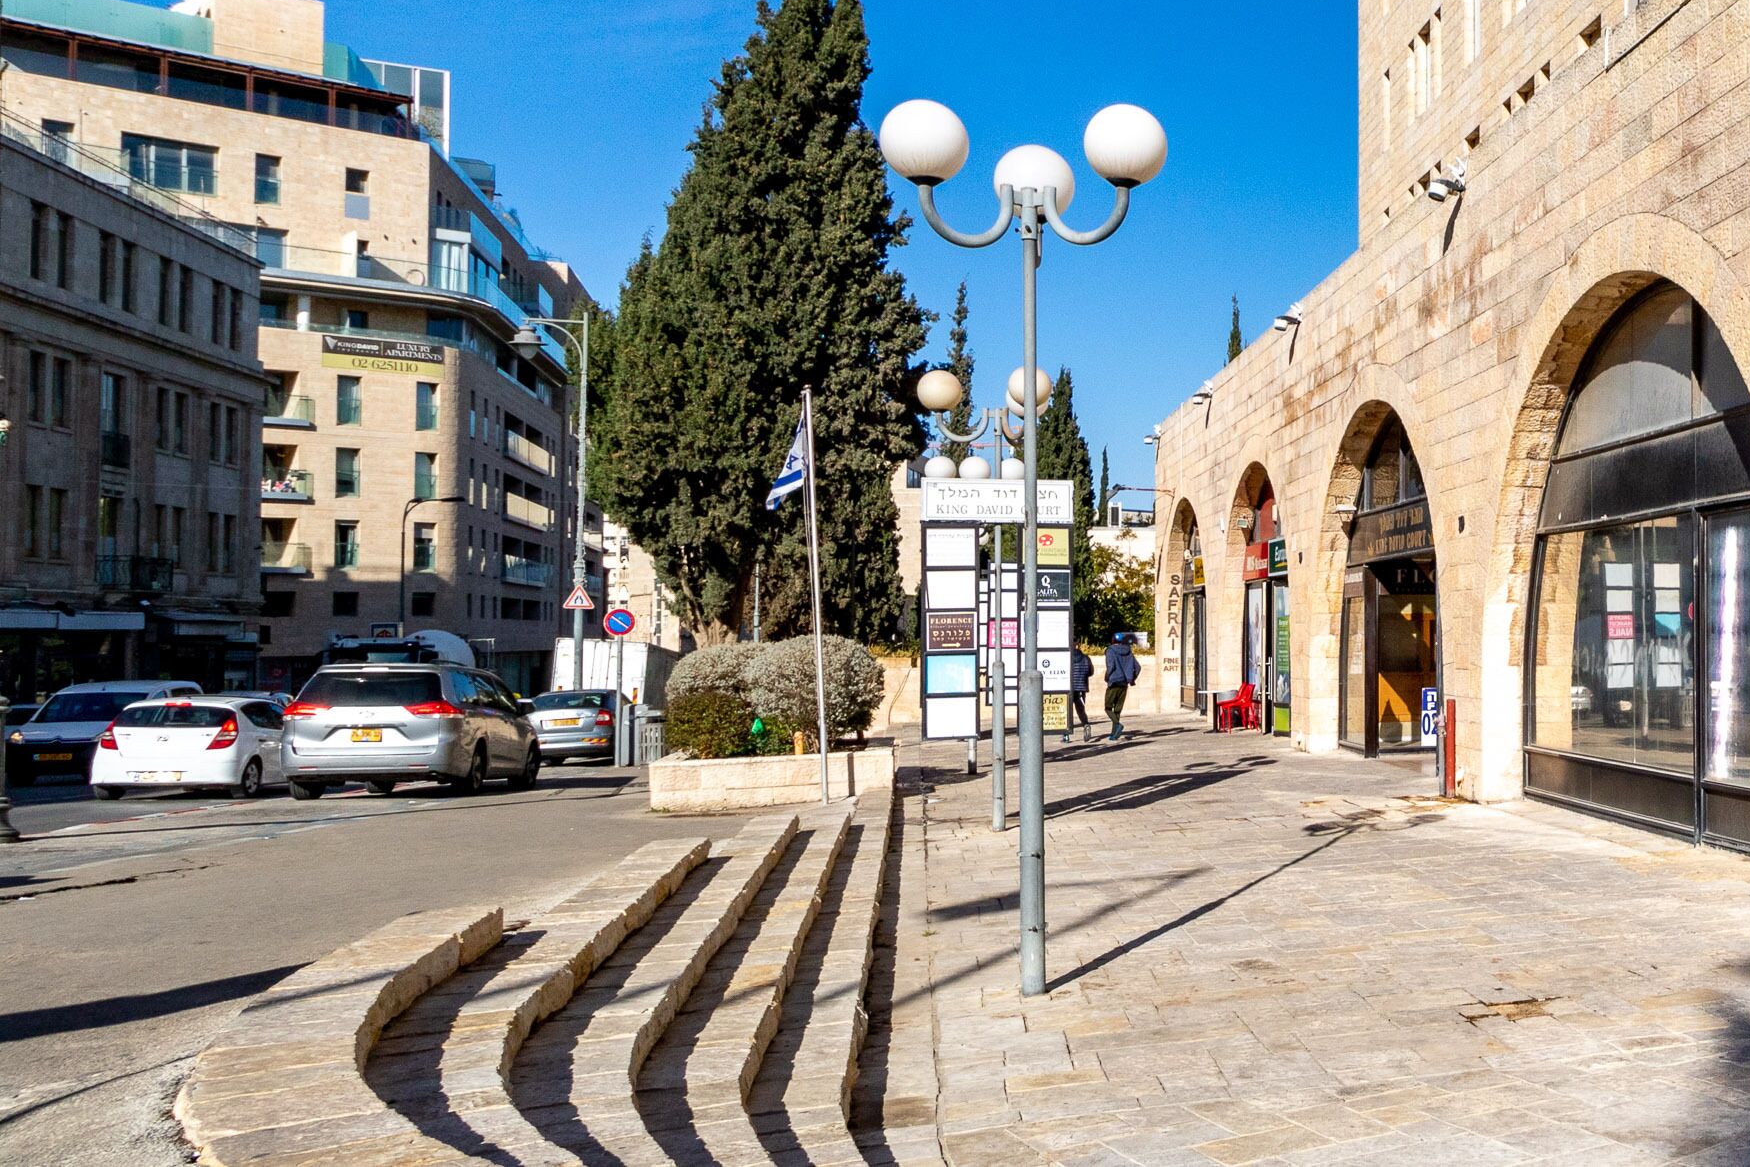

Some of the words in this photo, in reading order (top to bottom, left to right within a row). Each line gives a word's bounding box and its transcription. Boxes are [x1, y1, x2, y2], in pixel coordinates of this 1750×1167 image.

[396, 343, 432, 353] LUXURY
[384, 349, 443, 361] APARTMENTS
[938, 486, 980, 500] המלך
[993, 488, 1018, 499] דוד
[936, 504, 968, 515] KING
[976, 504, 1013, 515] DAVID
[930, 617, 973, 625] FLORENCE
